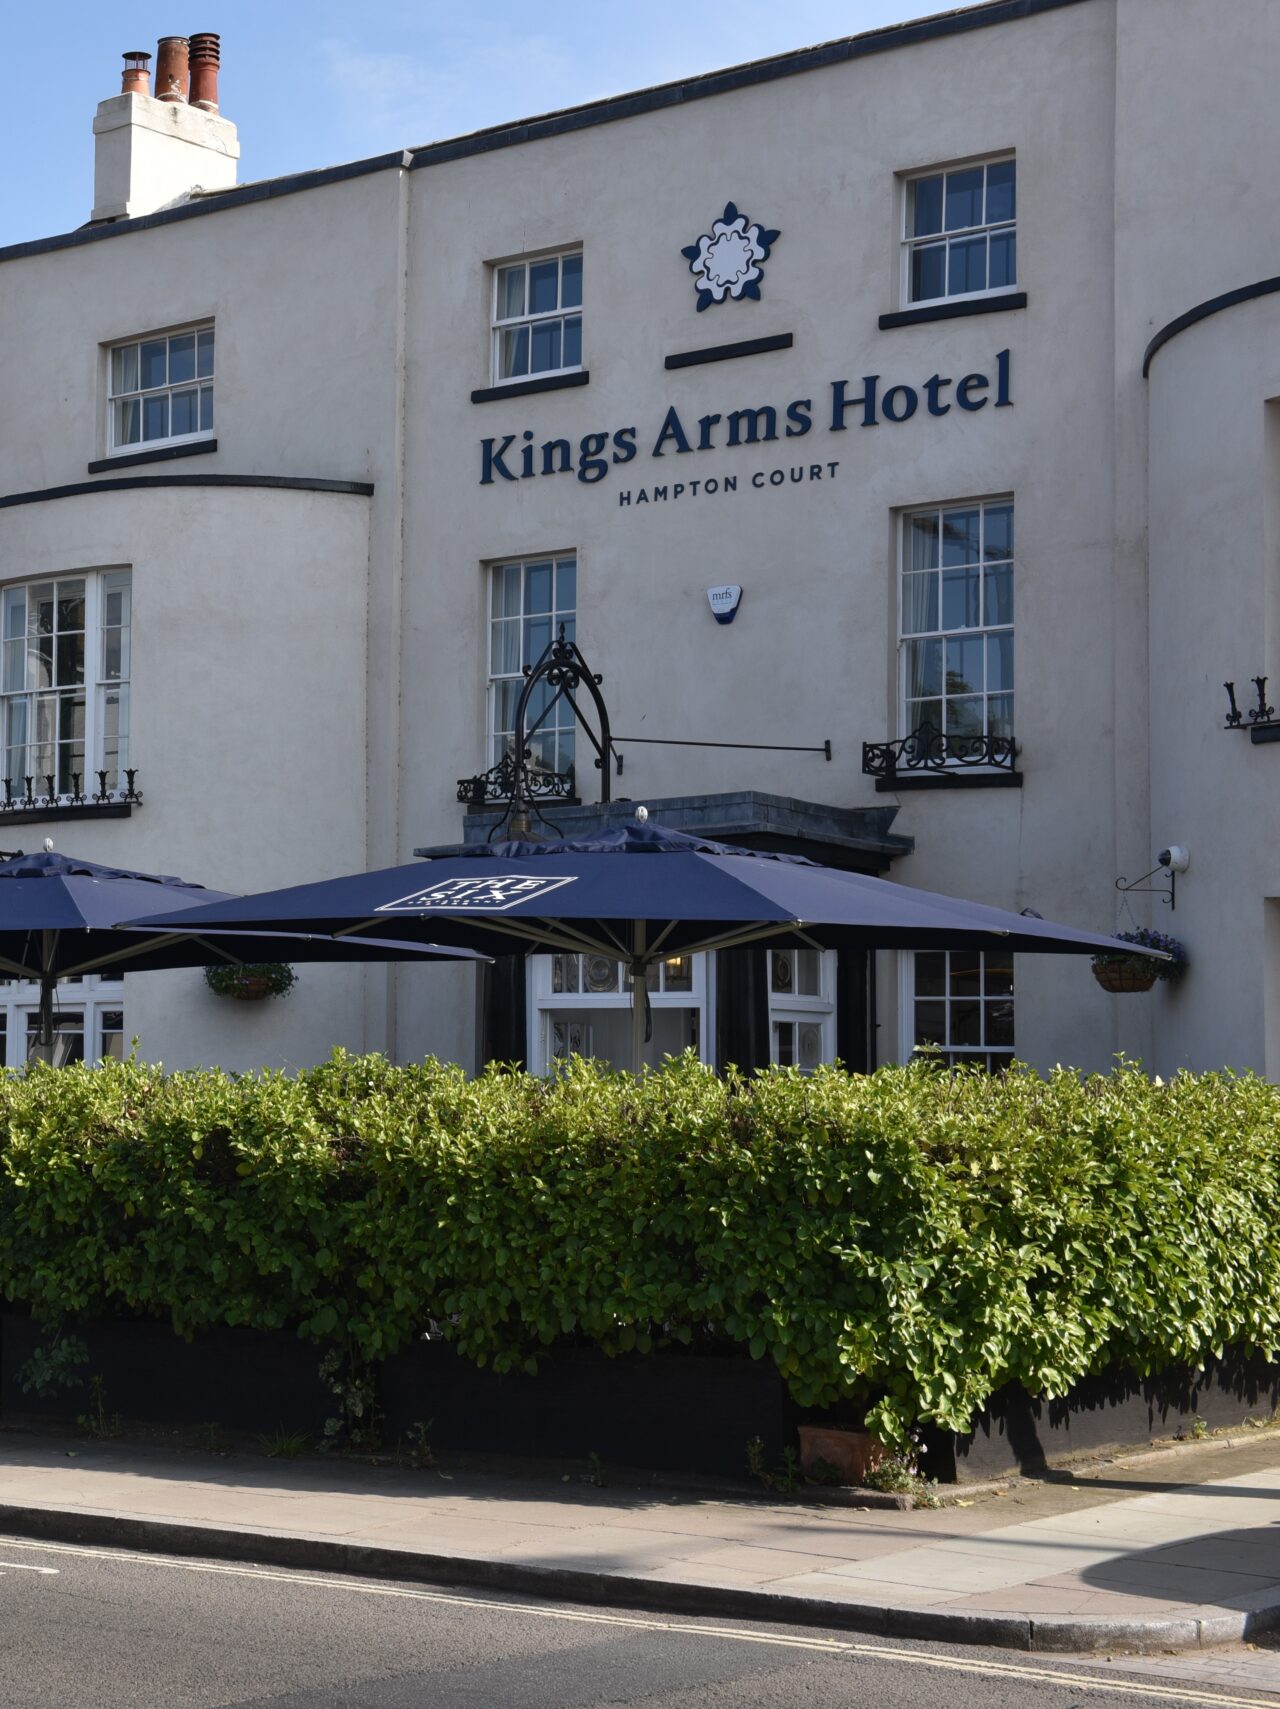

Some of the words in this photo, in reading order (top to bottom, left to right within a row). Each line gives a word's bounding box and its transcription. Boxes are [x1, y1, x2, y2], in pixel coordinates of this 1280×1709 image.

[478, 424, 638, 485] Kings
[651, 399, 812, 457] Arms
[828, 348, 1015, 432] Hotel
[619, 475, 738, 507] HAMPTON
[751, 461, 841, 489] COURT
[419, 889, 523, 901] SIX
[449, 879, 547, 890] THE
